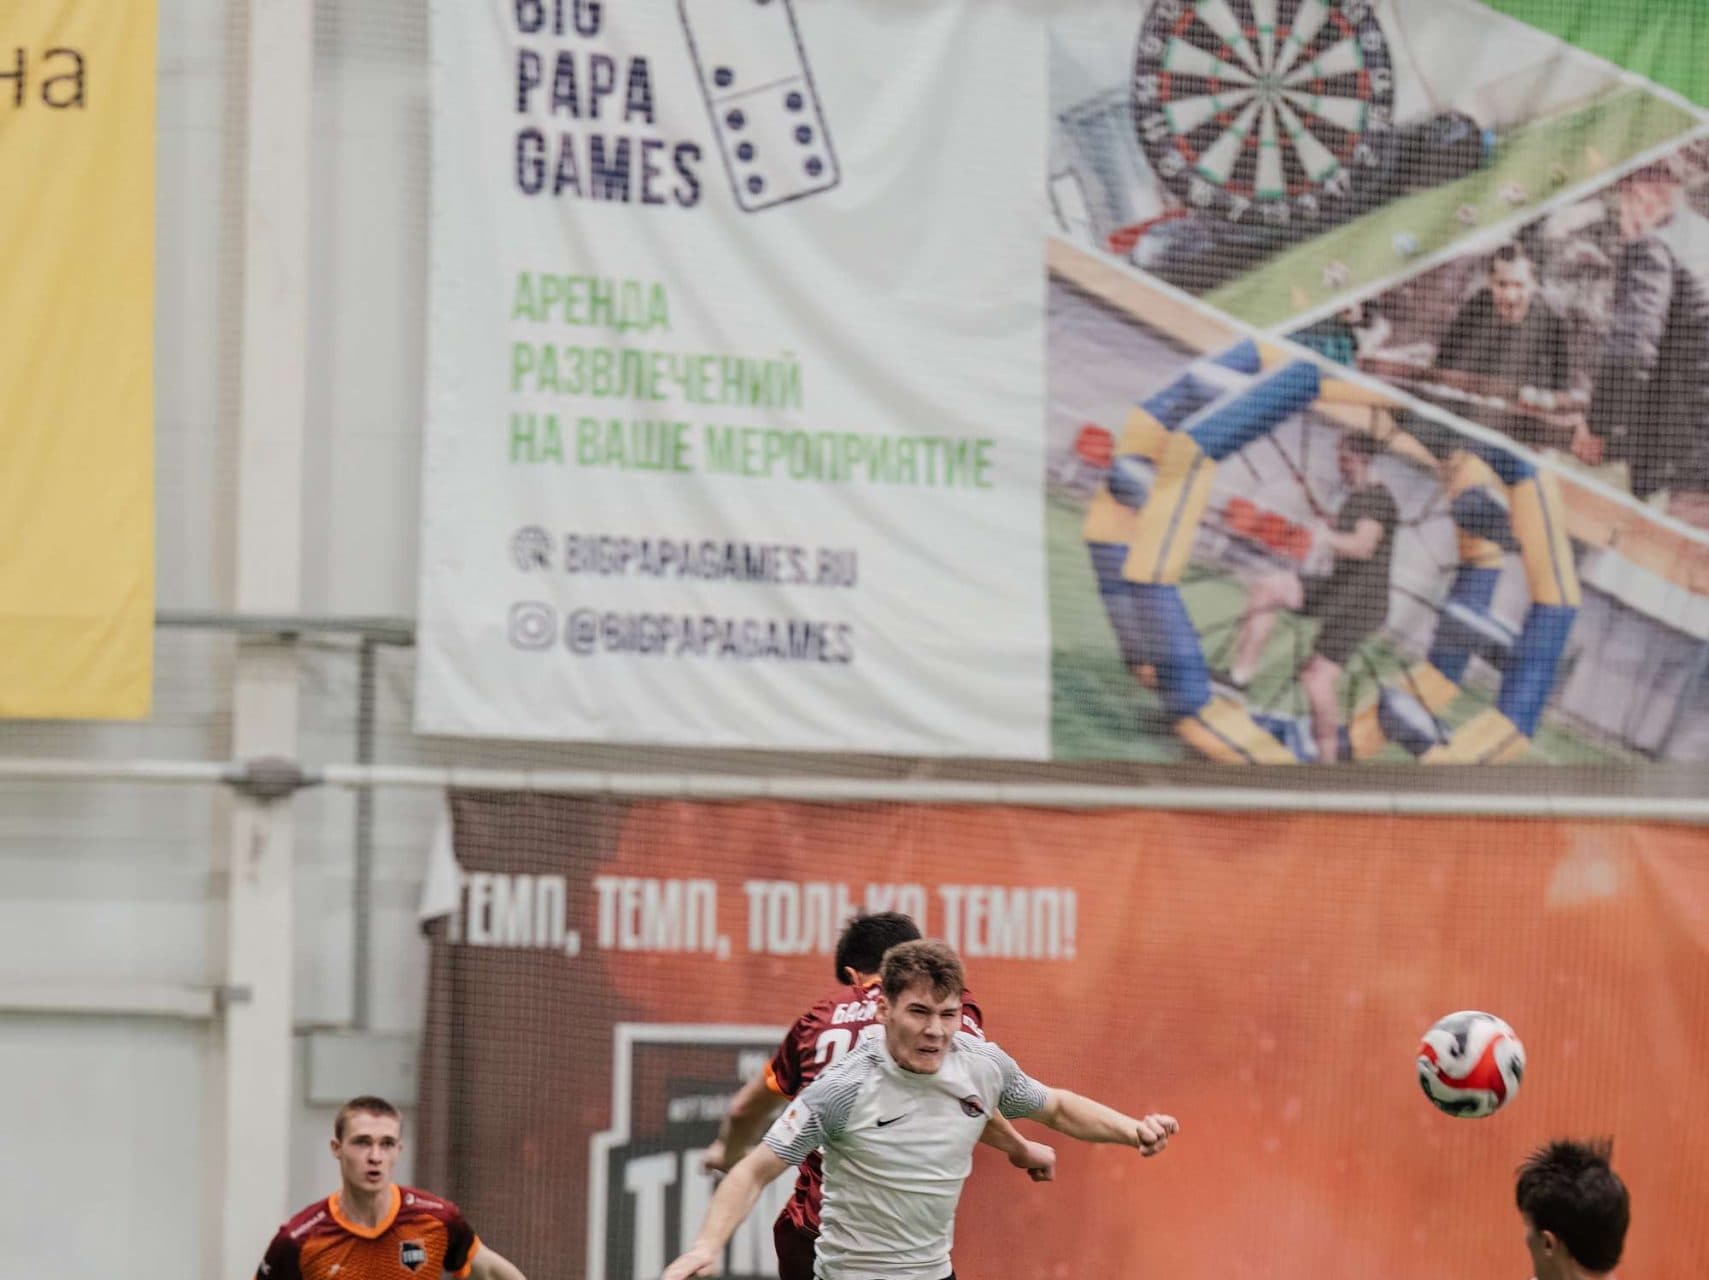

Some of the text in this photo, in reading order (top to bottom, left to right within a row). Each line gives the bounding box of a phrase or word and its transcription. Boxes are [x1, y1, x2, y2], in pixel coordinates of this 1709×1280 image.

[517, 48, 655, 124] PAPA
[517, 126, 702, 208] GAMES
[511, 270, 671, 333] АРЕНДА
[511, 342, 803, 409] РАЗВЛЕЧЕНИЙ
[509, 412, 998, 489] НА ВАШЕ МЕРОПРИЯТИЕ
[565, 533, 857, 587] BIGPAPAGAMES.RU
[596, 874, 731, 960] ТЕМП,
[938, 885, 1077, 960] ТЕМП!
